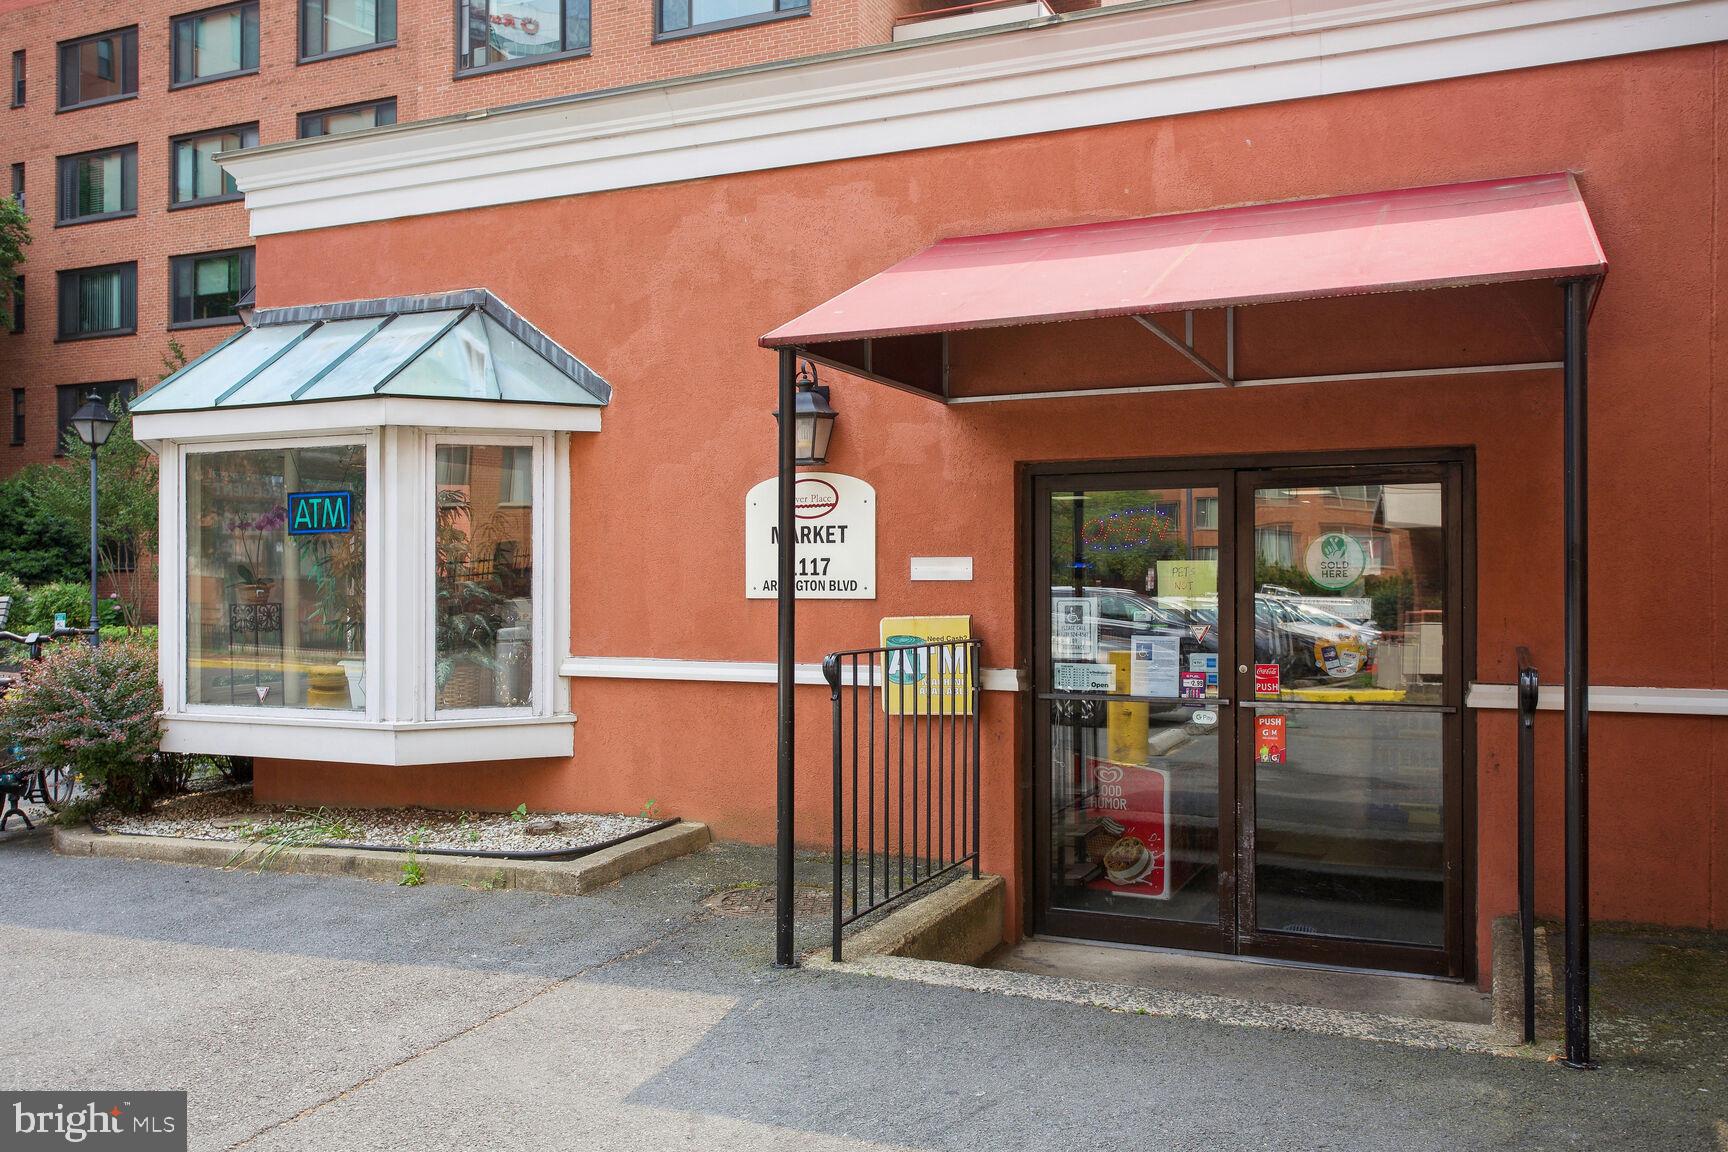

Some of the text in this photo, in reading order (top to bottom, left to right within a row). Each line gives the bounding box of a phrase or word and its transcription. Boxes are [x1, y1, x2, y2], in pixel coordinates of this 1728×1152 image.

[811, 494, 832, 503] Place
[294, 497, 346, 529] ATM
[1082, 516, 1172, 543] OPEN
[794, 557, 831, 576] 117
[1320, 561, 1349, 570] SOLD
[1321, 570, 1348, 578] HERE
[763, 580, 858, 592] ARGTON BLVD
[889, 645, 967, 674] ATM
[1091, 681, 1109, 689] Open
[1256, 683, 1279, 691] PUSH
[1203, 714, 1214, 722] Pay
[1259, 718, 1281, 726] PUSH
[1101, 785, 1122, 797] OOD
[1090, 797, 1127, 810] HUMOR
